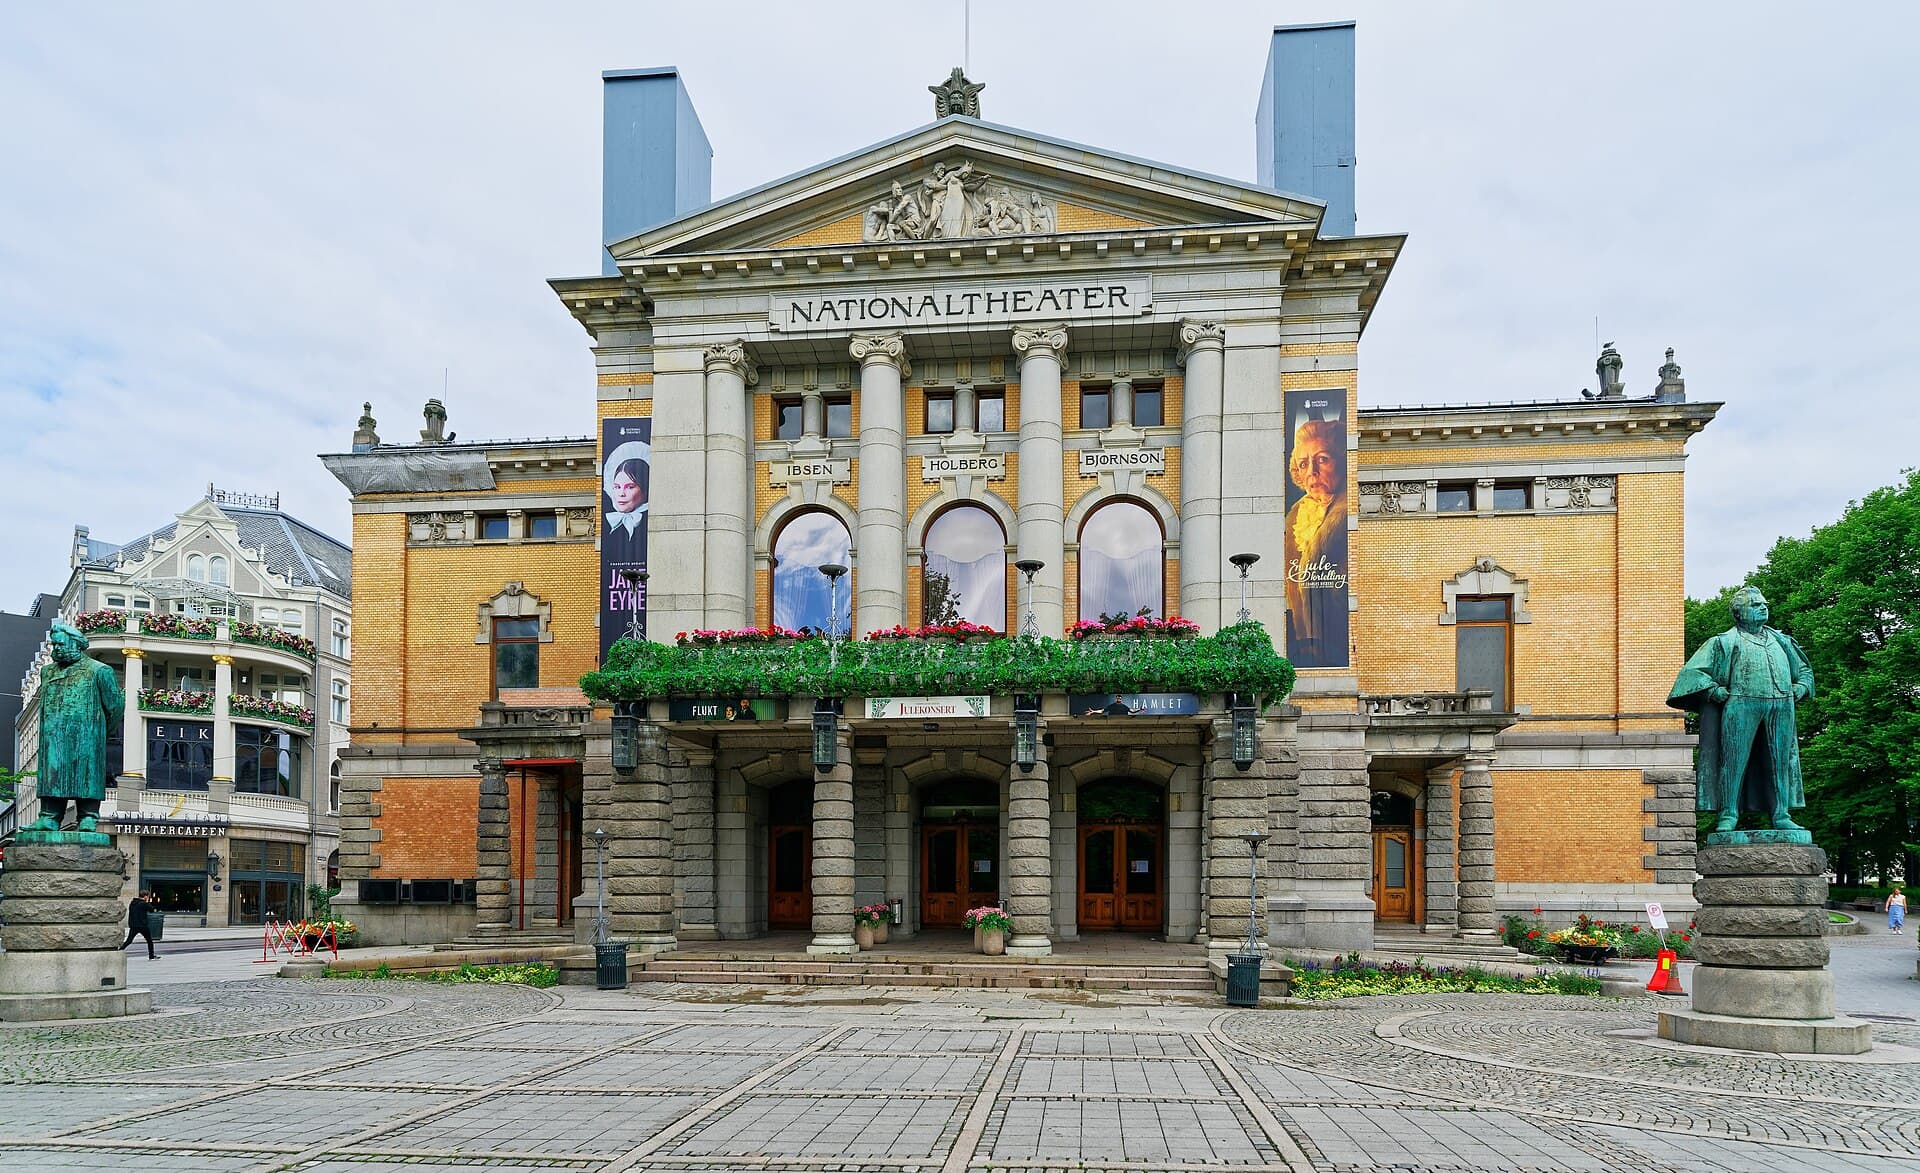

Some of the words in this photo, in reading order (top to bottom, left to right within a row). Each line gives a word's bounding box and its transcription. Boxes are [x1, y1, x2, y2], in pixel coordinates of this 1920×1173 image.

[791, 286, 1130, 323] NATIONALTHEATER
[930, 459, 998, 471] HOLBERG
[1085, 452, 1160, 467] BJØRNSON
[787, 464, 833, 476] IBSEN
[1133, 698, 1183, 709] HAMLET
[692, 705, 718, 716] FLUKT
[156, 726, 209, 740] EIK
[115, 824, 226, 837] THEATERCAFEEN
